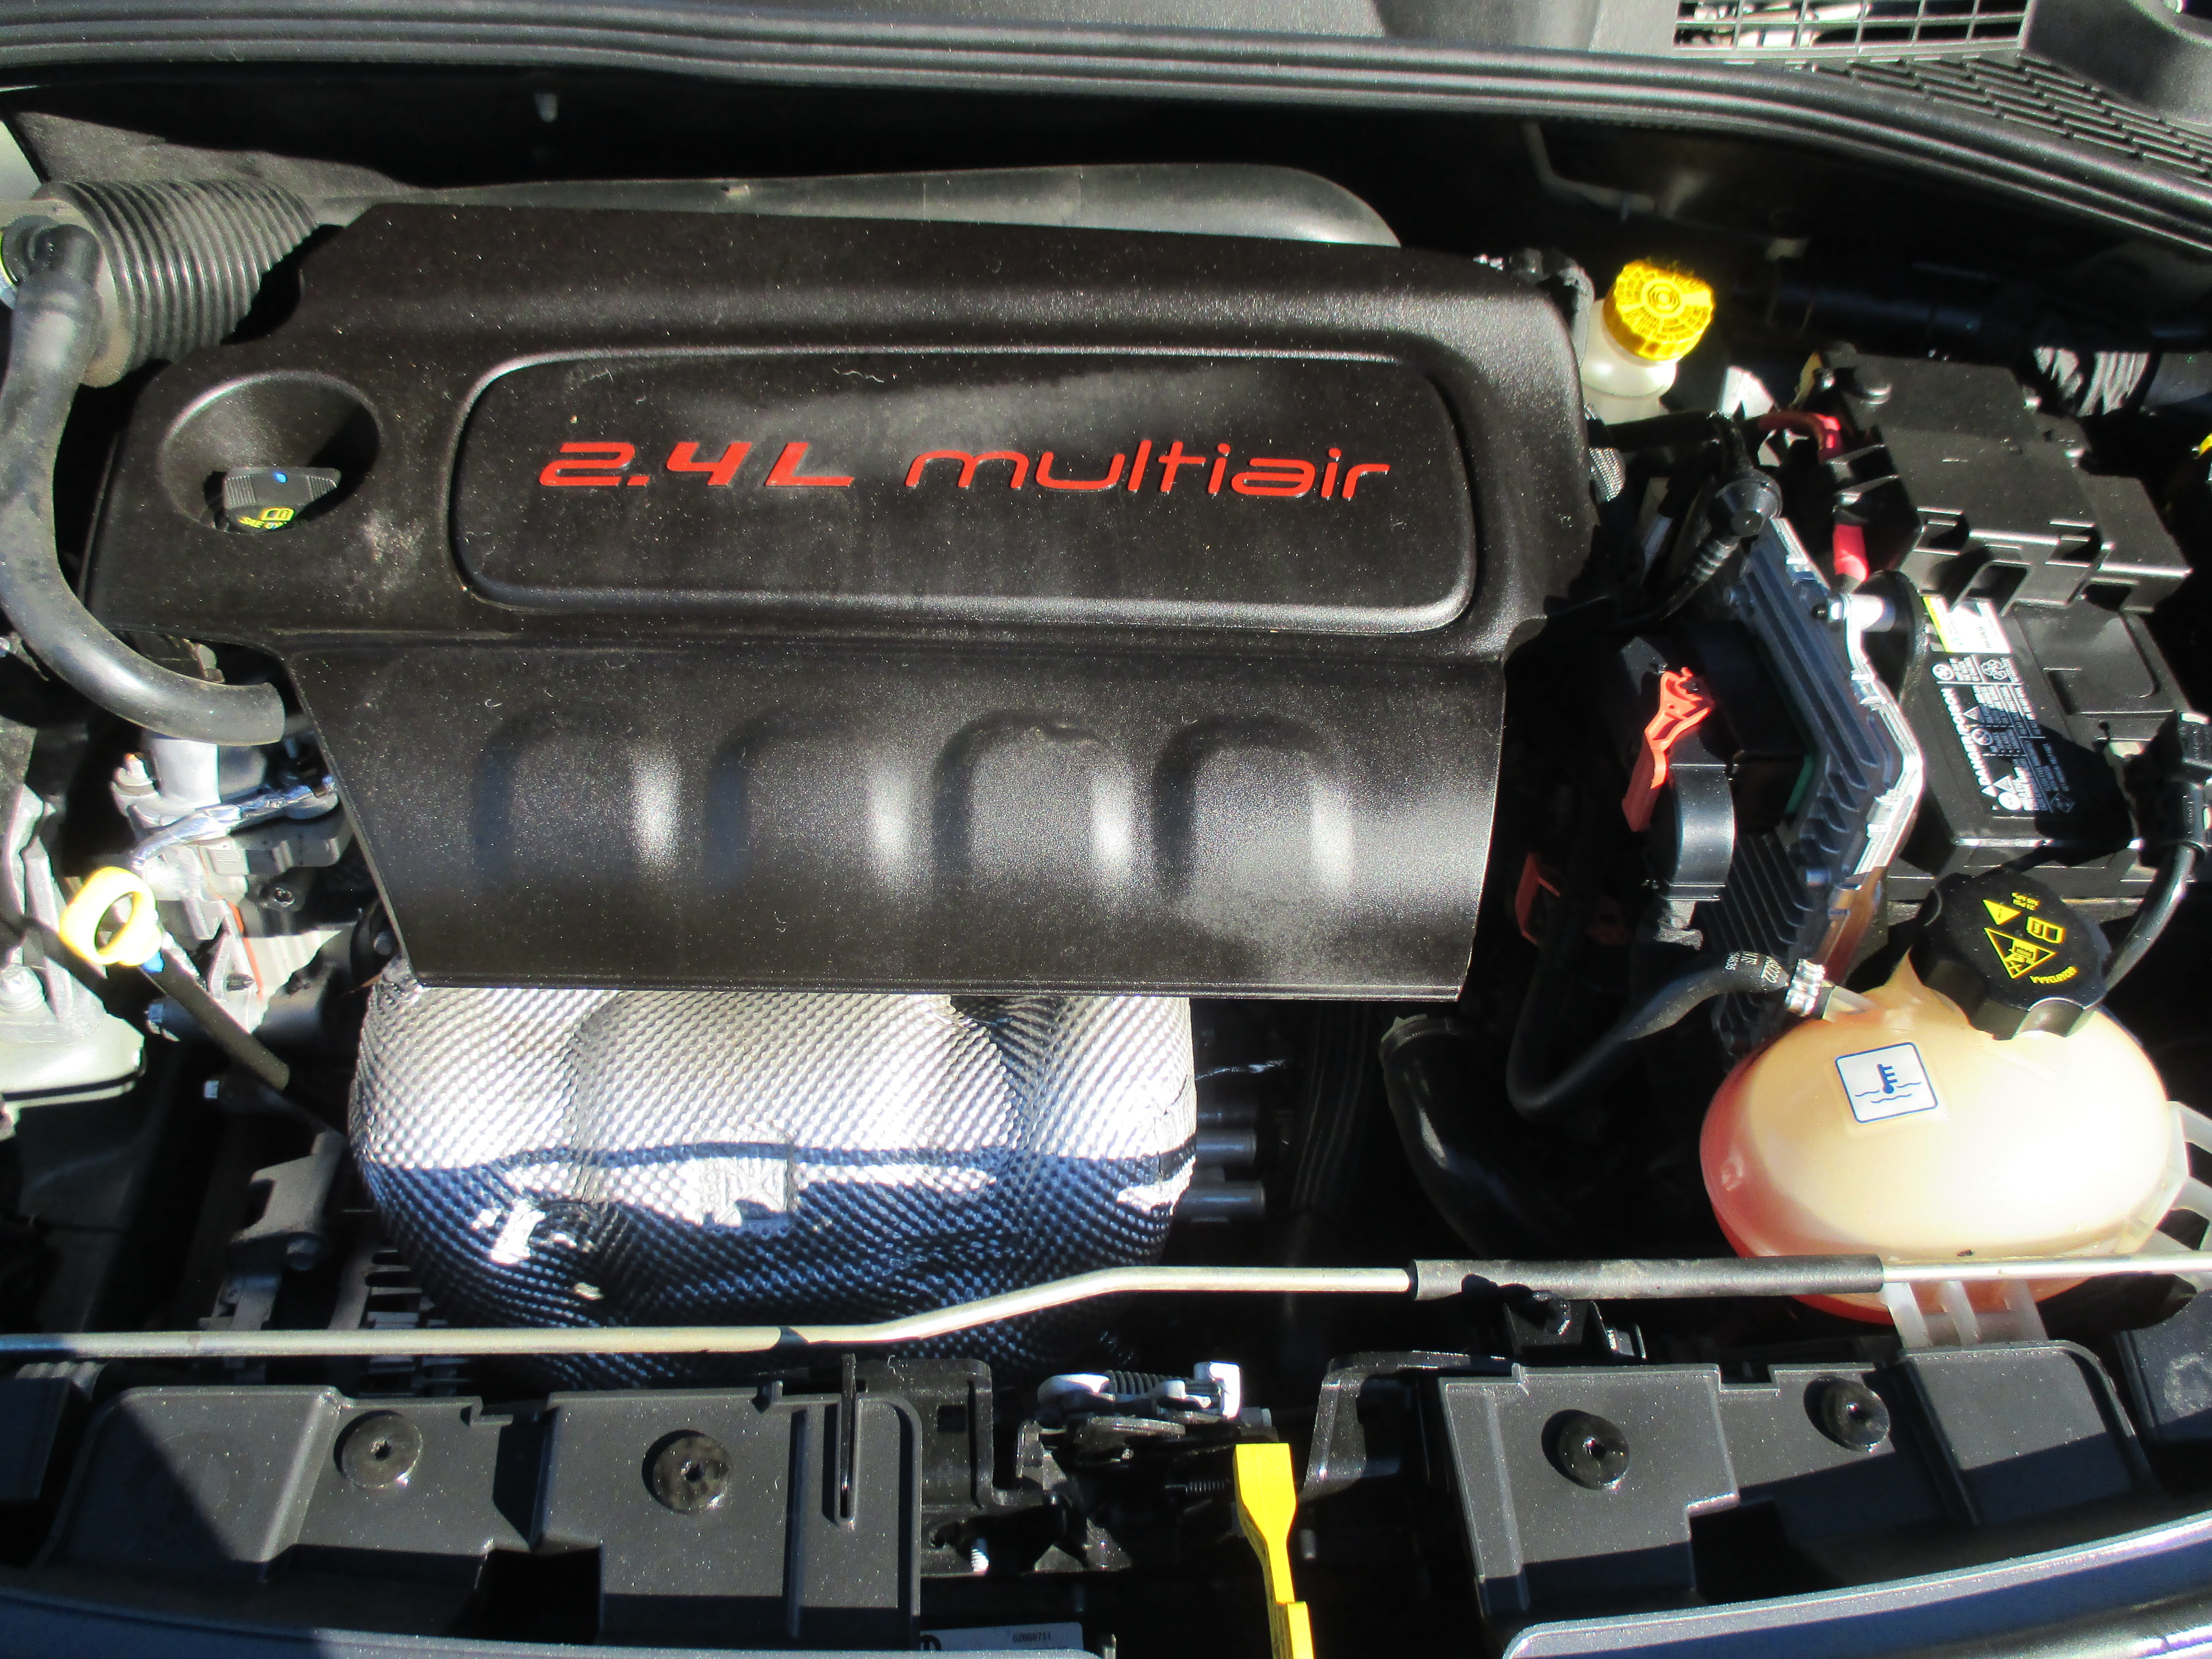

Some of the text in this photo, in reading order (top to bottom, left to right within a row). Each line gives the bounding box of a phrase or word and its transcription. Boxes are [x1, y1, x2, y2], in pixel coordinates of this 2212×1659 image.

[905, 440, 1390, 498] multiair
[239, 516, 264, 529] SAE
[1939, 687, 1993, 787] DANGER/POISON
